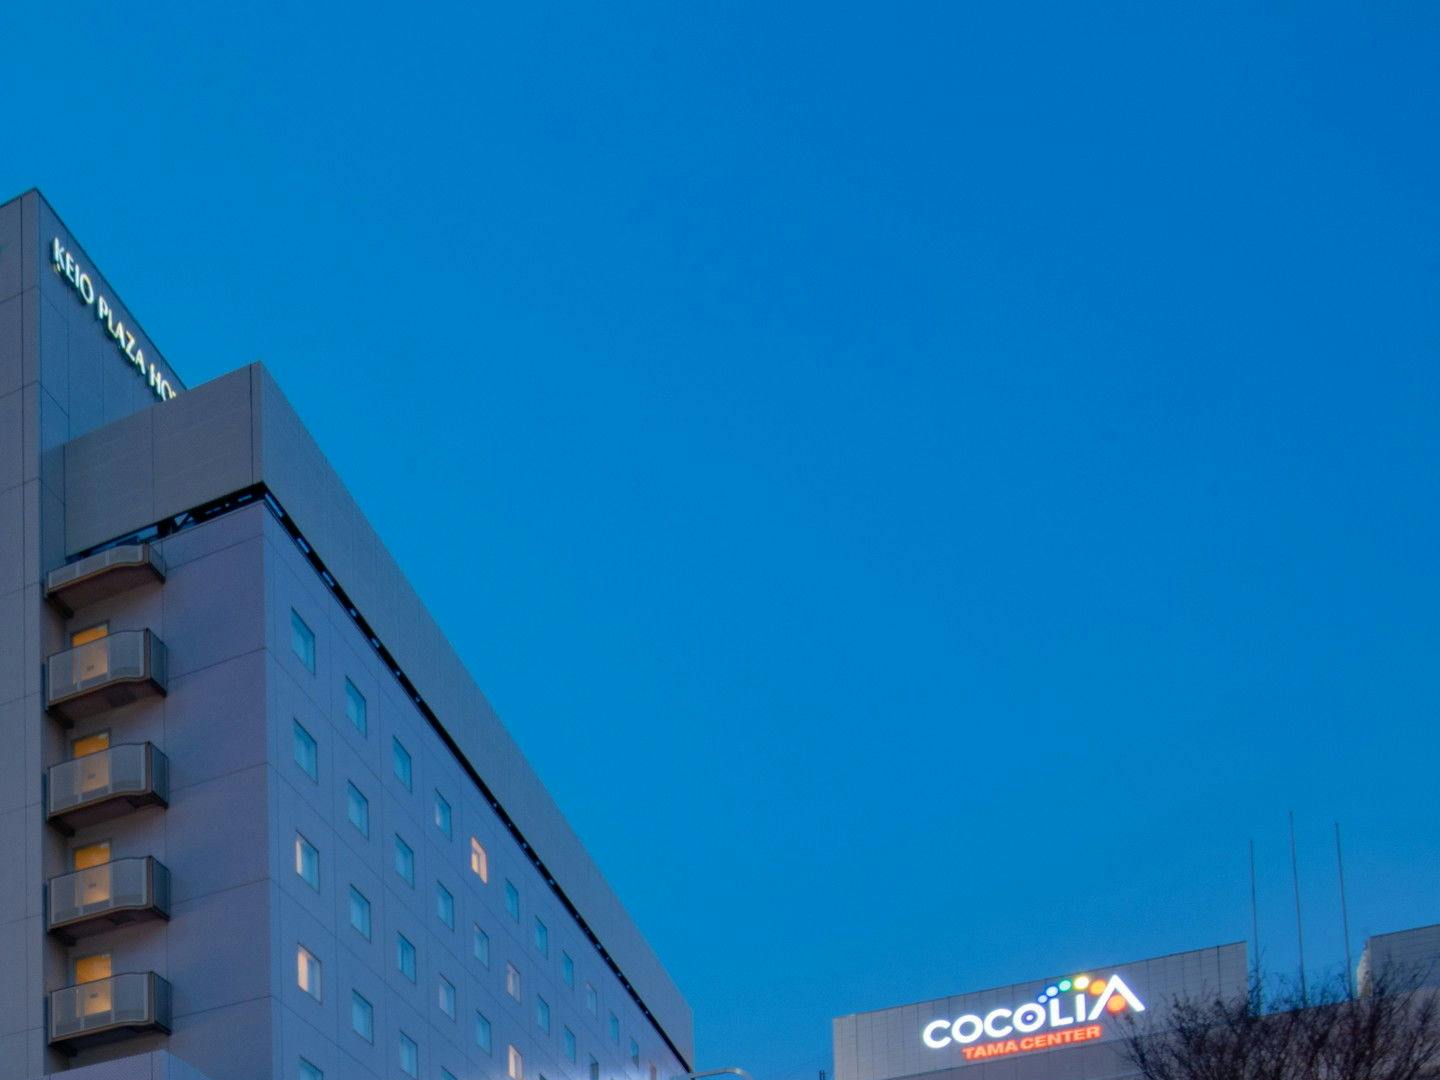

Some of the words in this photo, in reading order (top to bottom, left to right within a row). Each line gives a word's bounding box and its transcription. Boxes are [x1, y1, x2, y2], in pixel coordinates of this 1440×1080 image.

[53, 237, 94, 304] KEIO
[98, 296, 146, 376] PLAZA
[149, 363, 177, 401] HO
[963, 1041, 1018, 1061] TAMA
[1020, 1024, 1103, 1050] CENTER
